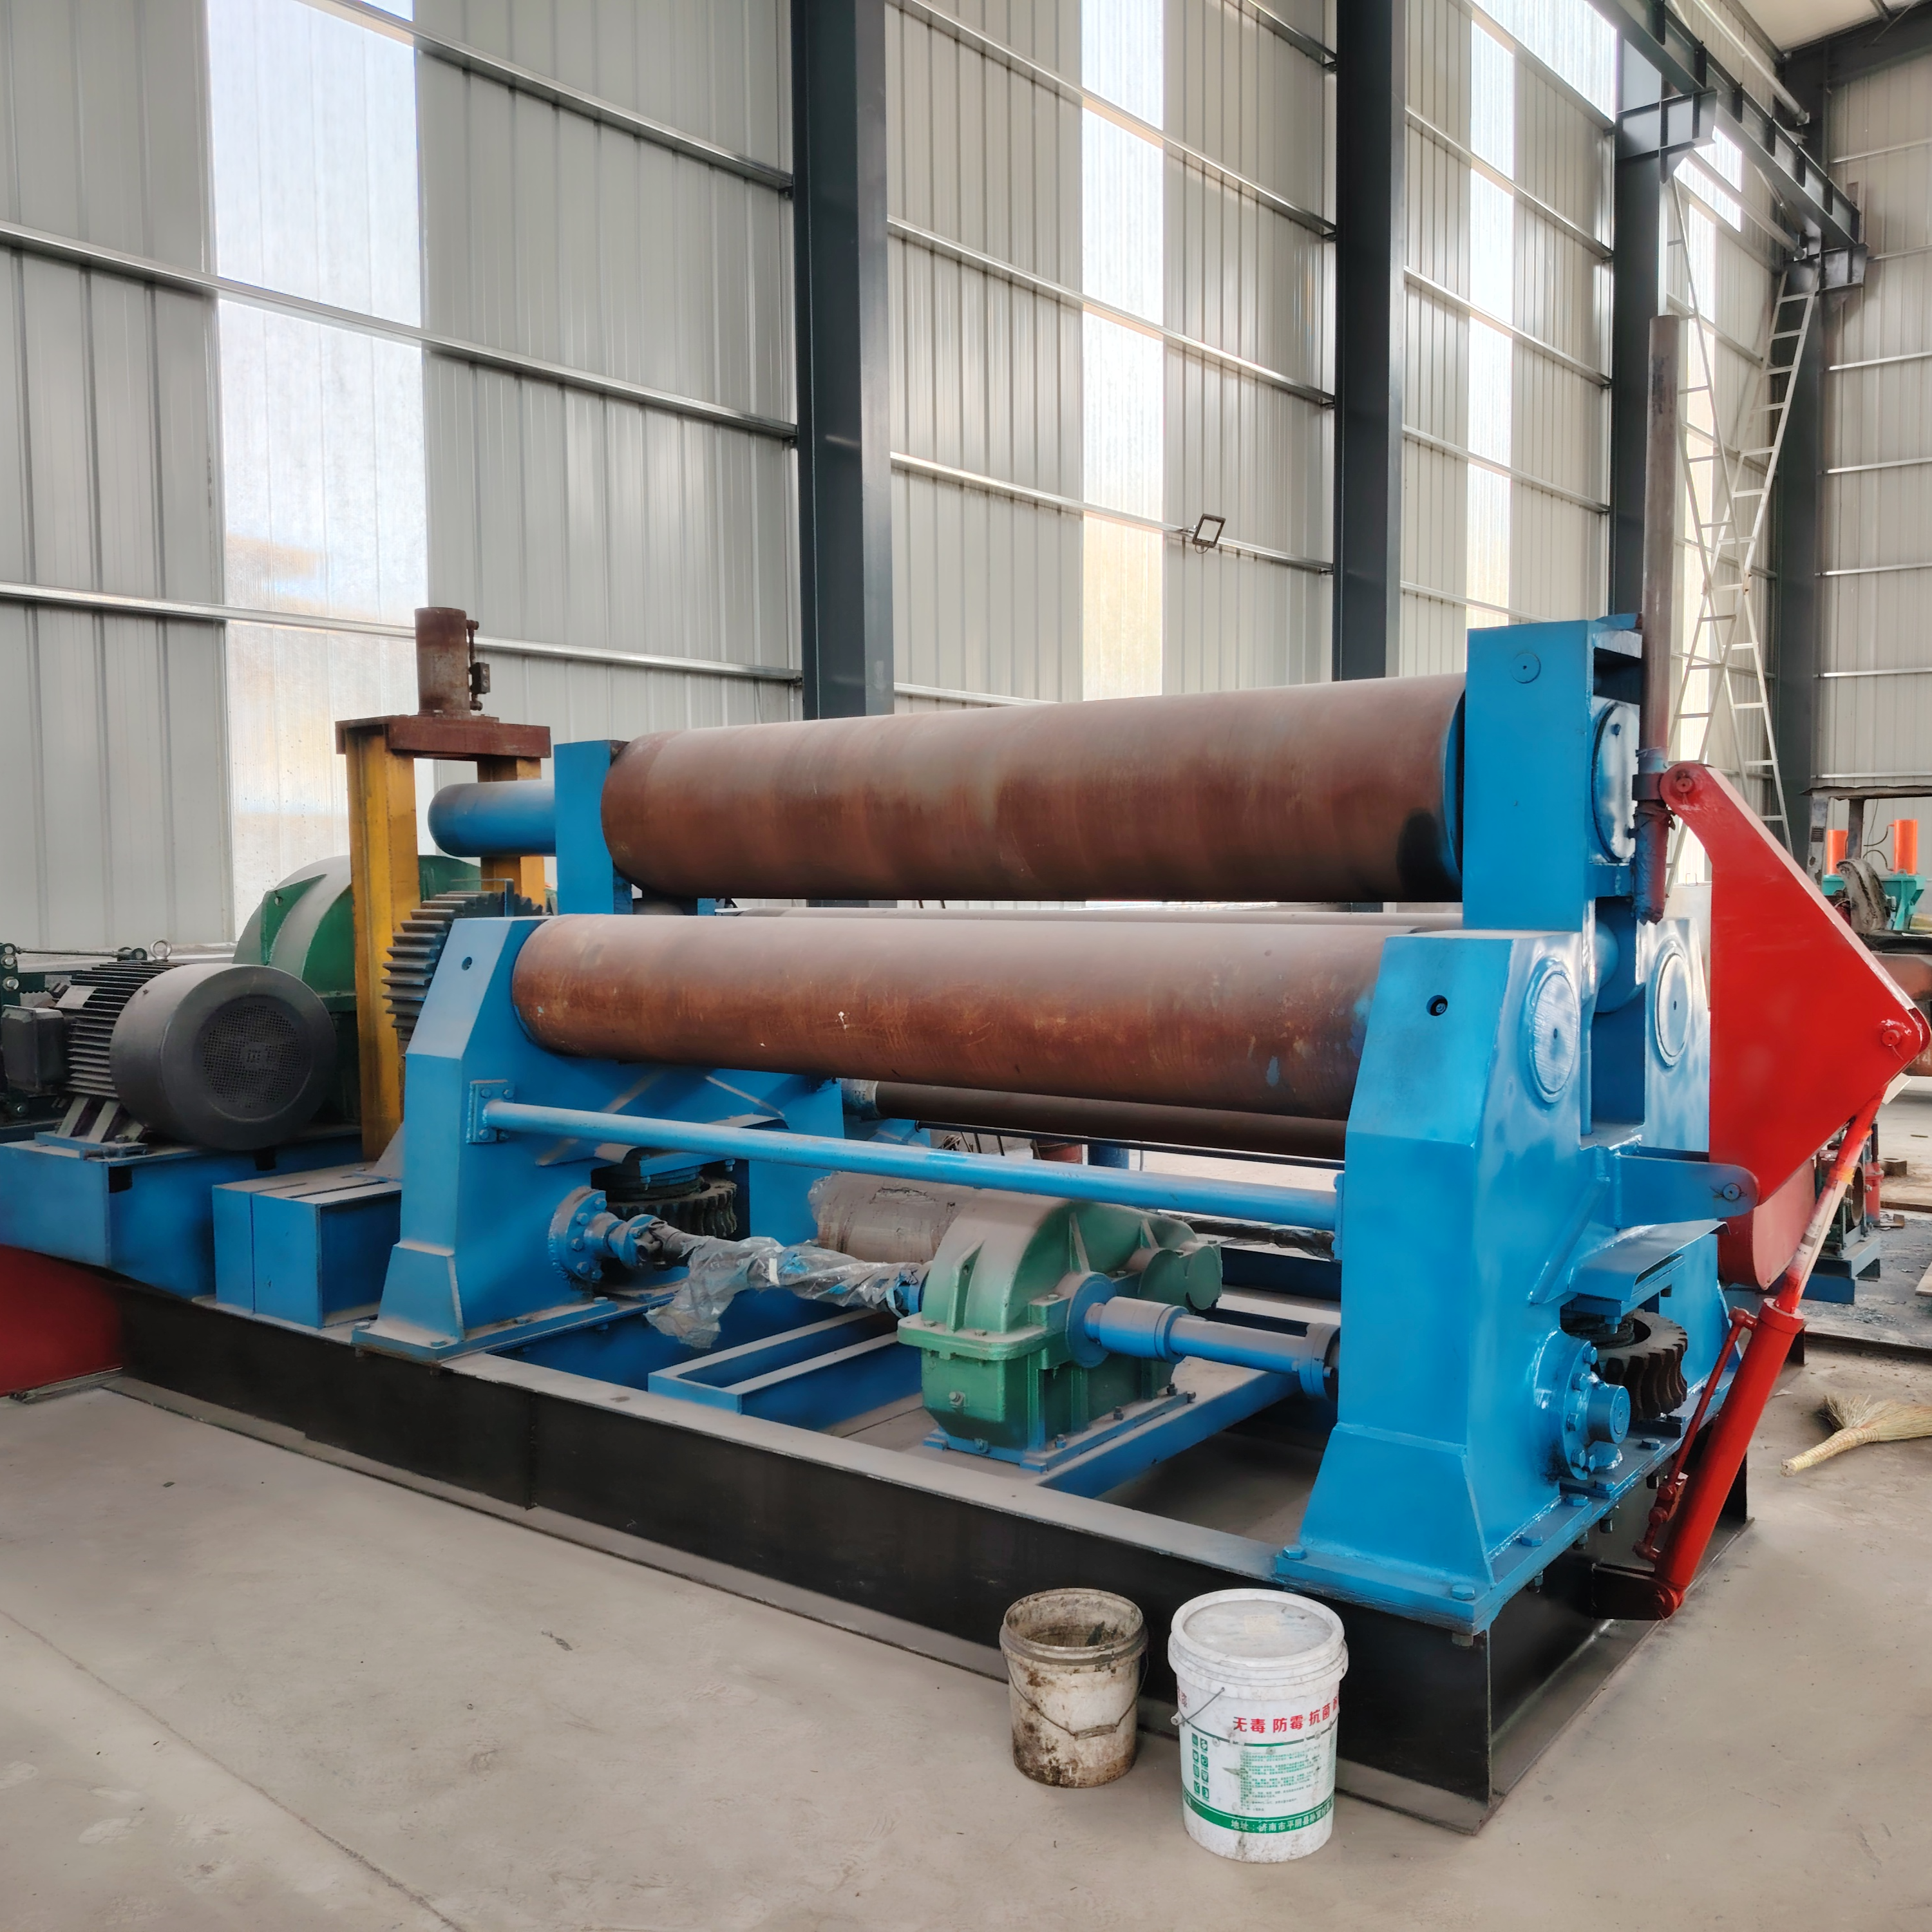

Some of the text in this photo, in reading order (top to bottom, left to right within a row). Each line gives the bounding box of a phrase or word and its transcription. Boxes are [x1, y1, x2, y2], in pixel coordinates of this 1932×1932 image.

[1233, 1716, 1266, 1734] 无毒
[1273, 1714, 1303, 1733] 防霉
[1309, 1702, 1331, 1727] 抗菌
